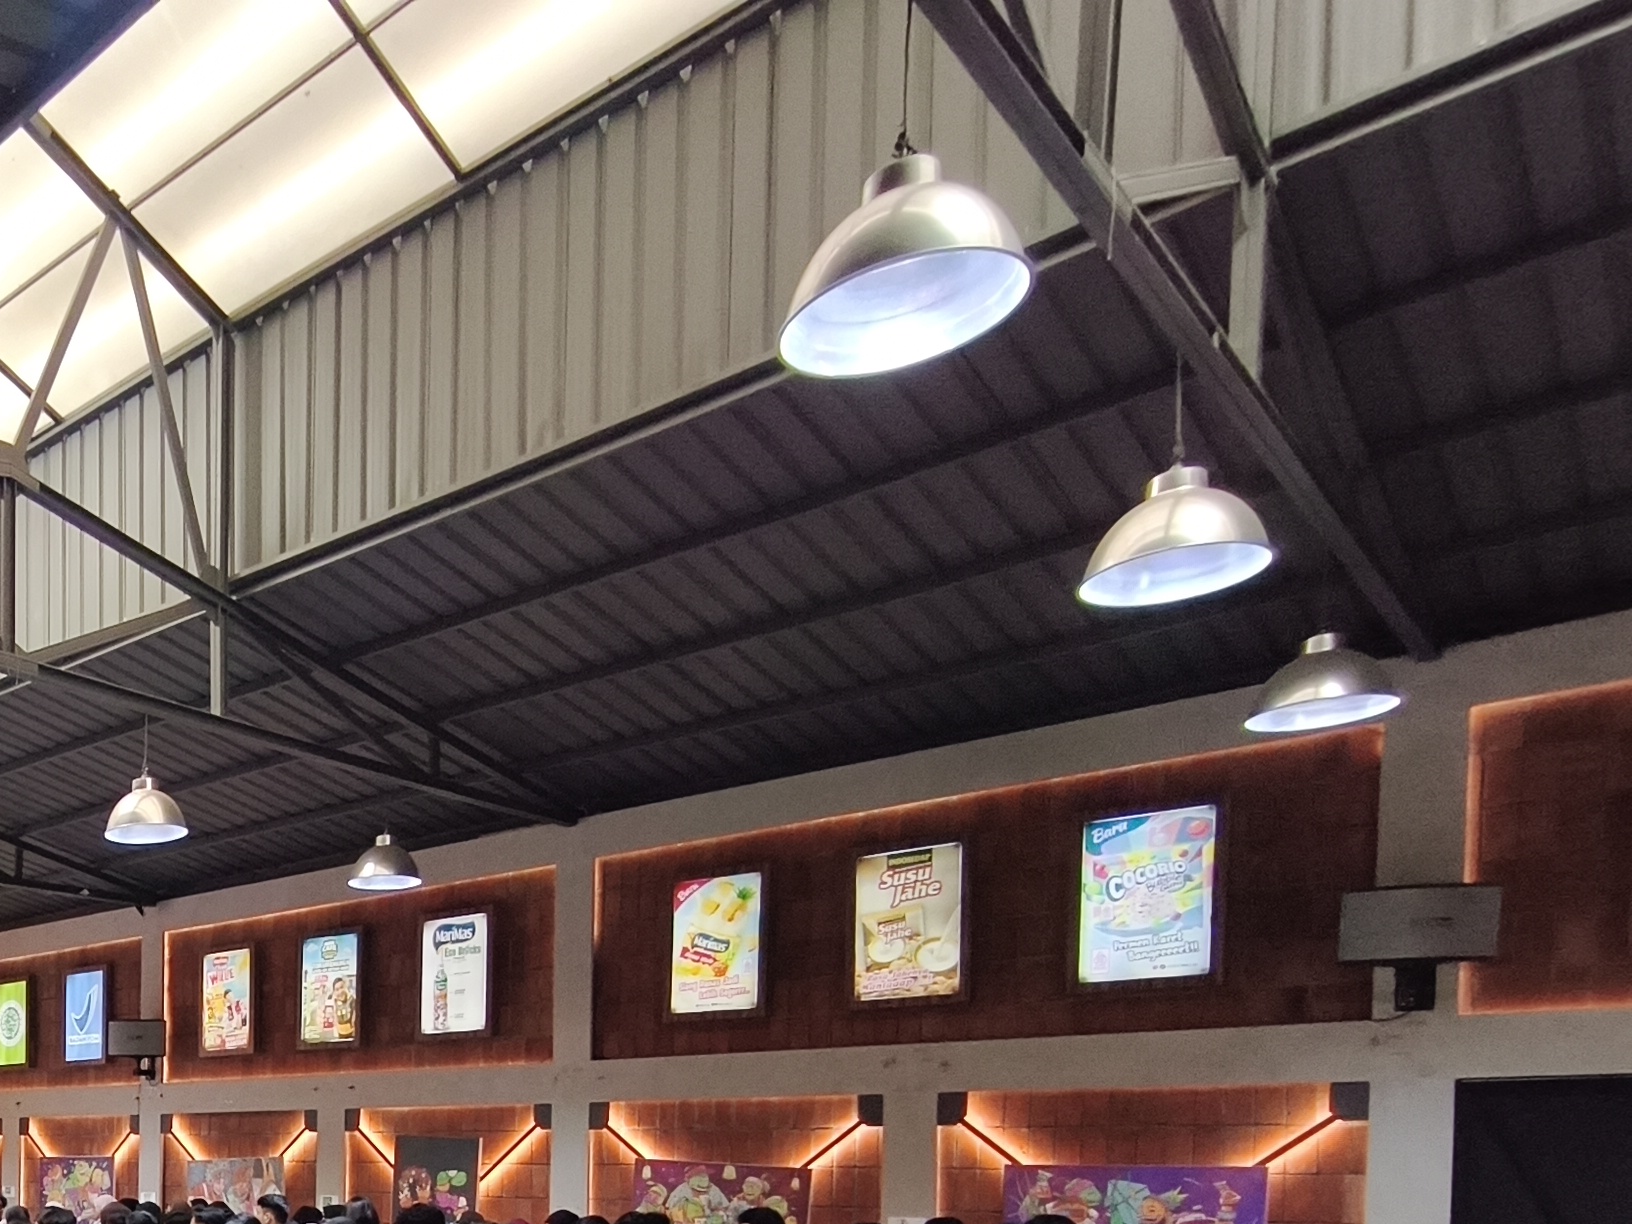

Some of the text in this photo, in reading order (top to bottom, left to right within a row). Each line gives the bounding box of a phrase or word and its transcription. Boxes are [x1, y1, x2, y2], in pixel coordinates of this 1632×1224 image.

[879, 866, 932, 890] Susu
[1106, 861, 1186, 902] COCORIO
[891, 880, 942, 908] Jahe
